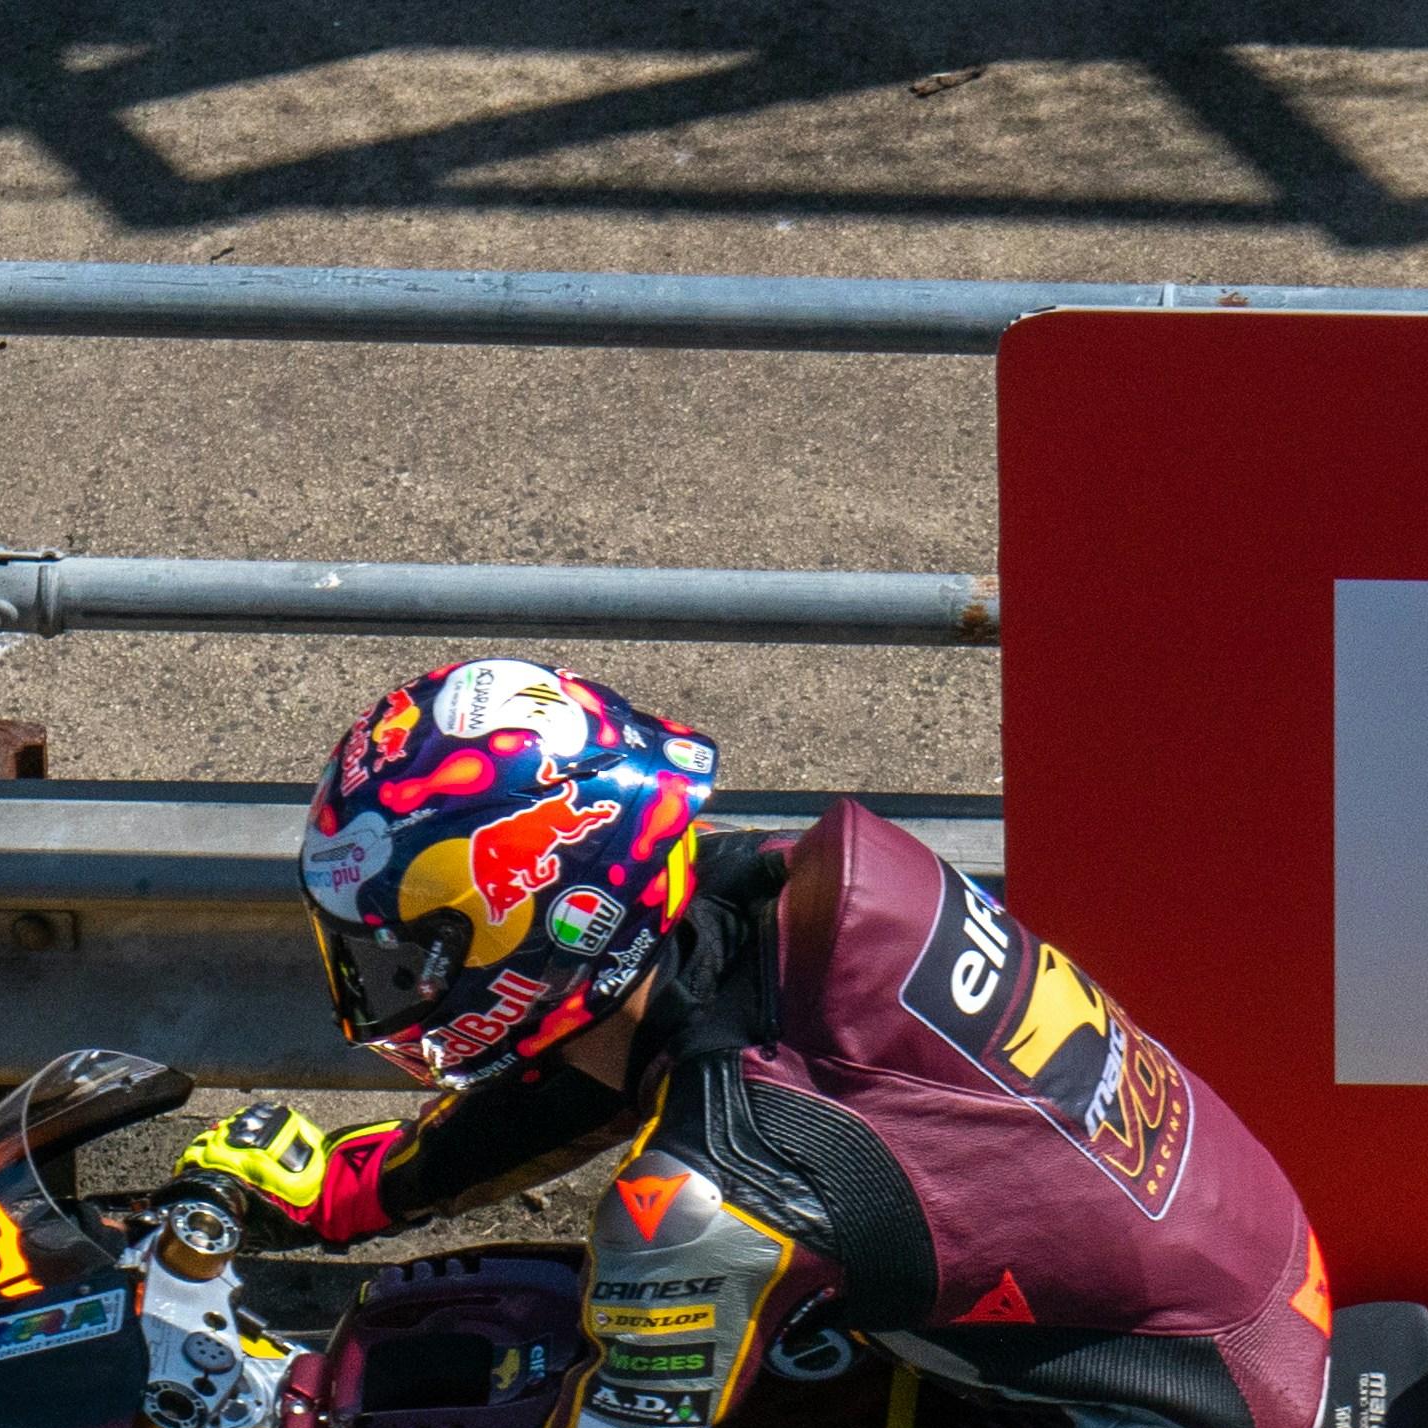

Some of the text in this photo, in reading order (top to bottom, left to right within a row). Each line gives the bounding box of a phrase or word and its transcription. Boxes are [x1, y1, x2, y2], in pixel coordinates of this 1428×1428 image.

[951, 889, 1009, 1015] elf
[1084, 1018, 1127, 1138] marc
[1147, 1100, 1182, 1196] RACING
[591, 1276, 726, 1301] DAINESE
[614, 1311, 710, 1329] DUNLOP
